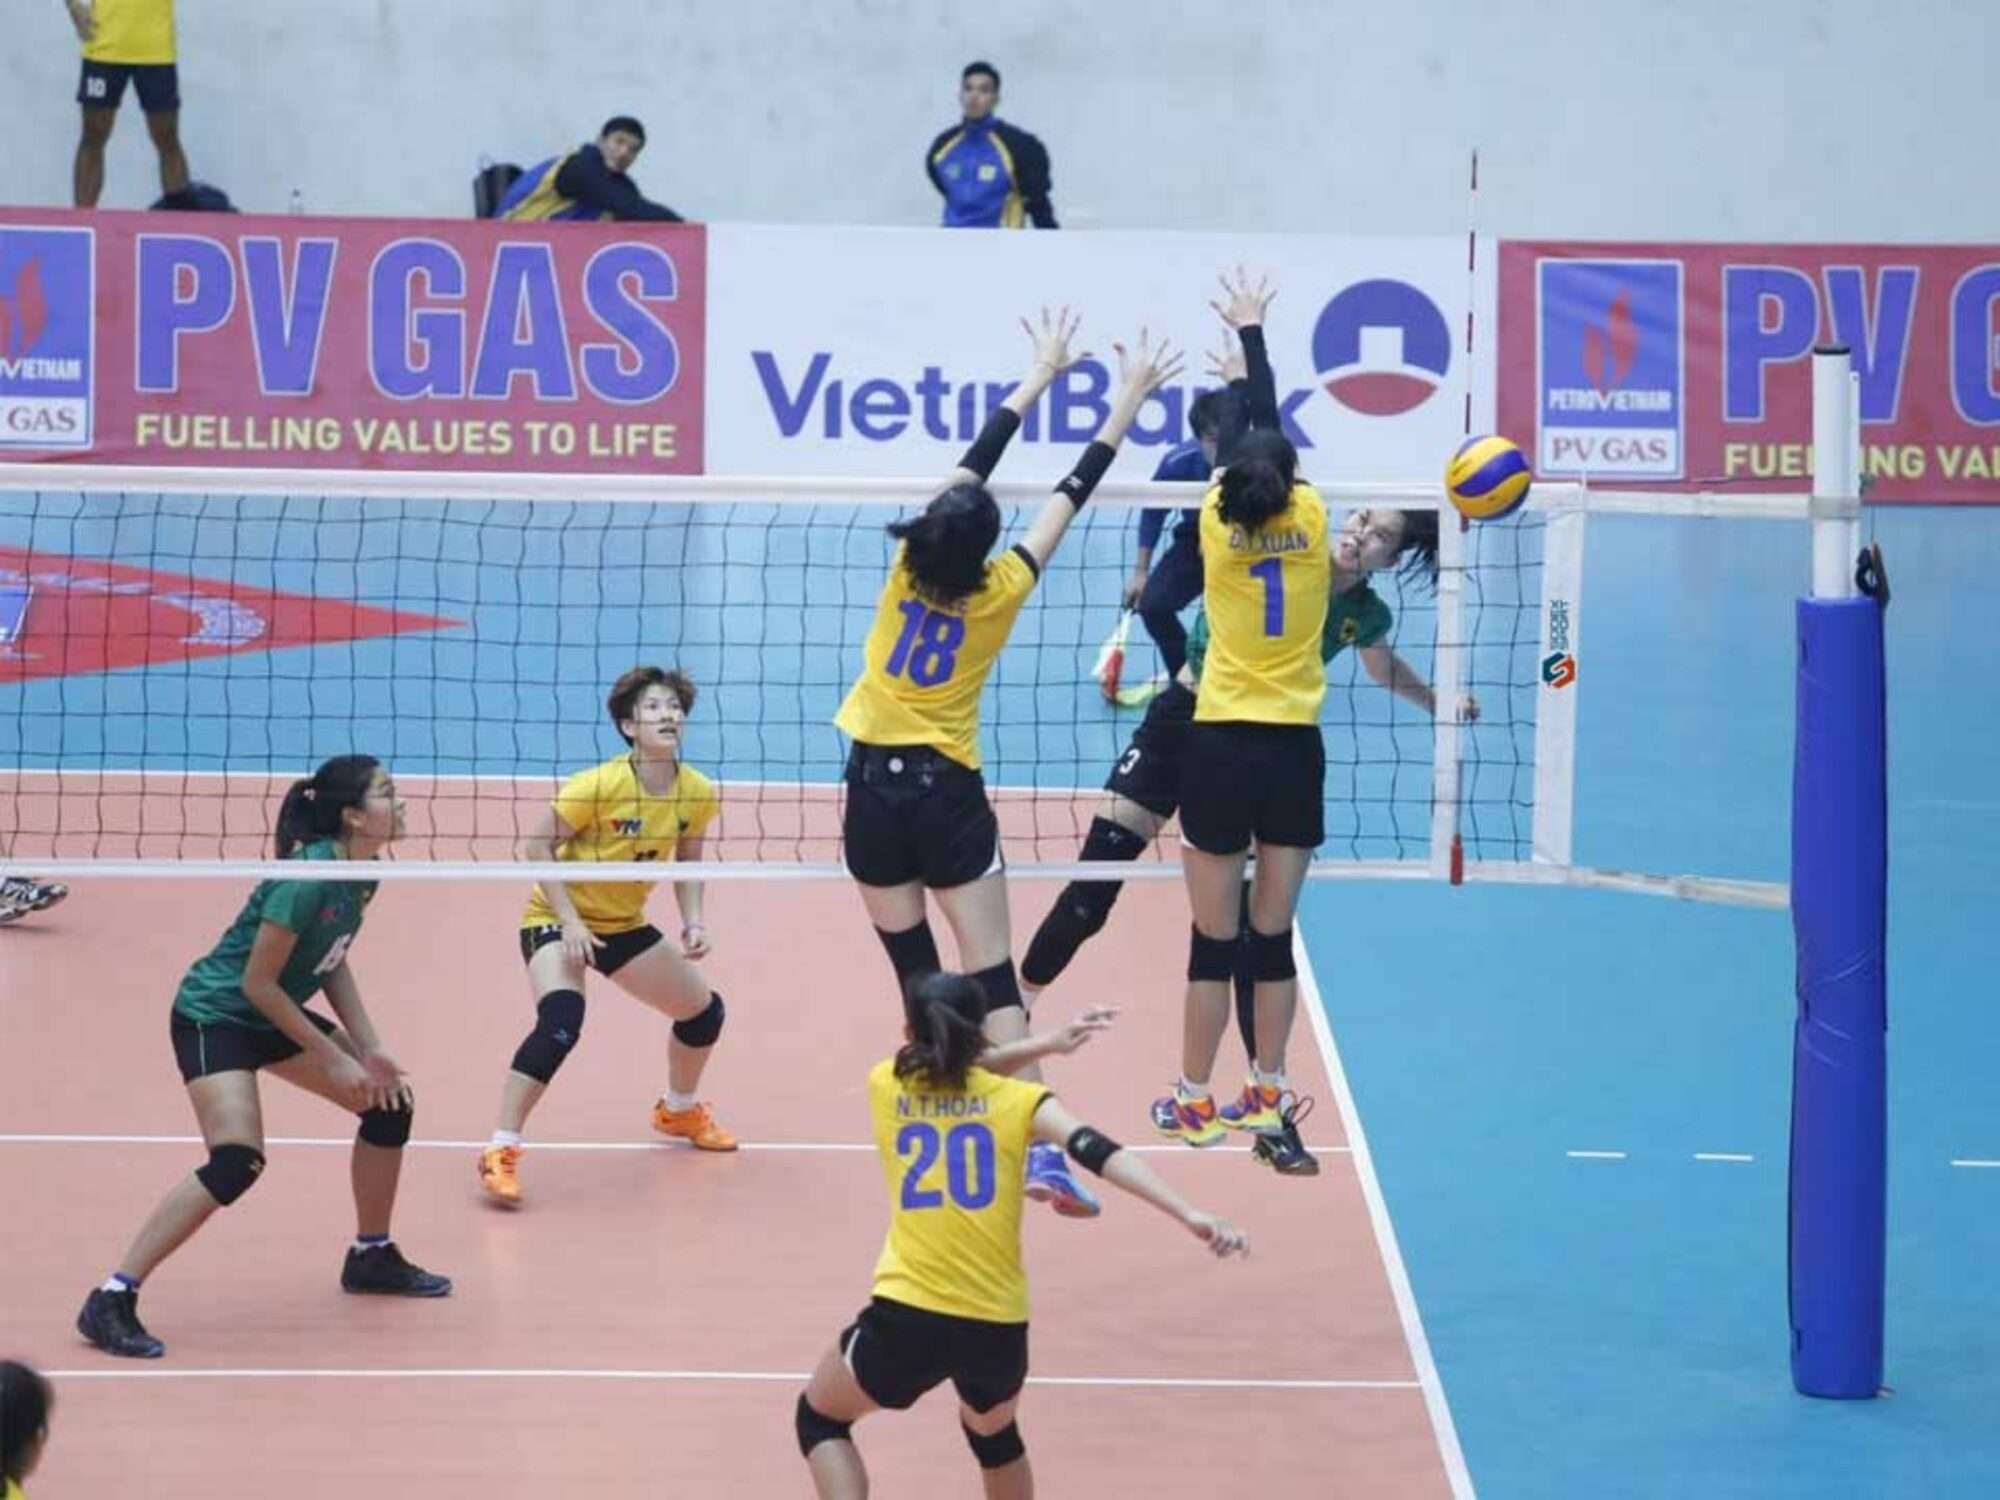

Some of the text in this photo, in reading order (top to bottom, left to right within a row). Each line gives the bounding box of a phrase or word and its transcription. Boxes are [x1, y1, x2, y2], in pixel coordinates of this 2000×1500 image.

[135, 232, 681, 403] PV GAS
[1722, 264, 1921, 424] PV
[7, 405, 77, 433] GAS
[137, 414, 677, 458] FUELLING VALUES TO LIFE
[751, 350, 1315, 448] VietinBak
[1549, 388, 1672, 411] PETROVIETNAM
[1552, 436, 1668, 462] PV GAS
[1249, 556, 1284, 637] 1
[885, 599, 967, 687] 18
[1119, 749, 1141, 774] 3
[896, 1121, 995, 1210] 20
